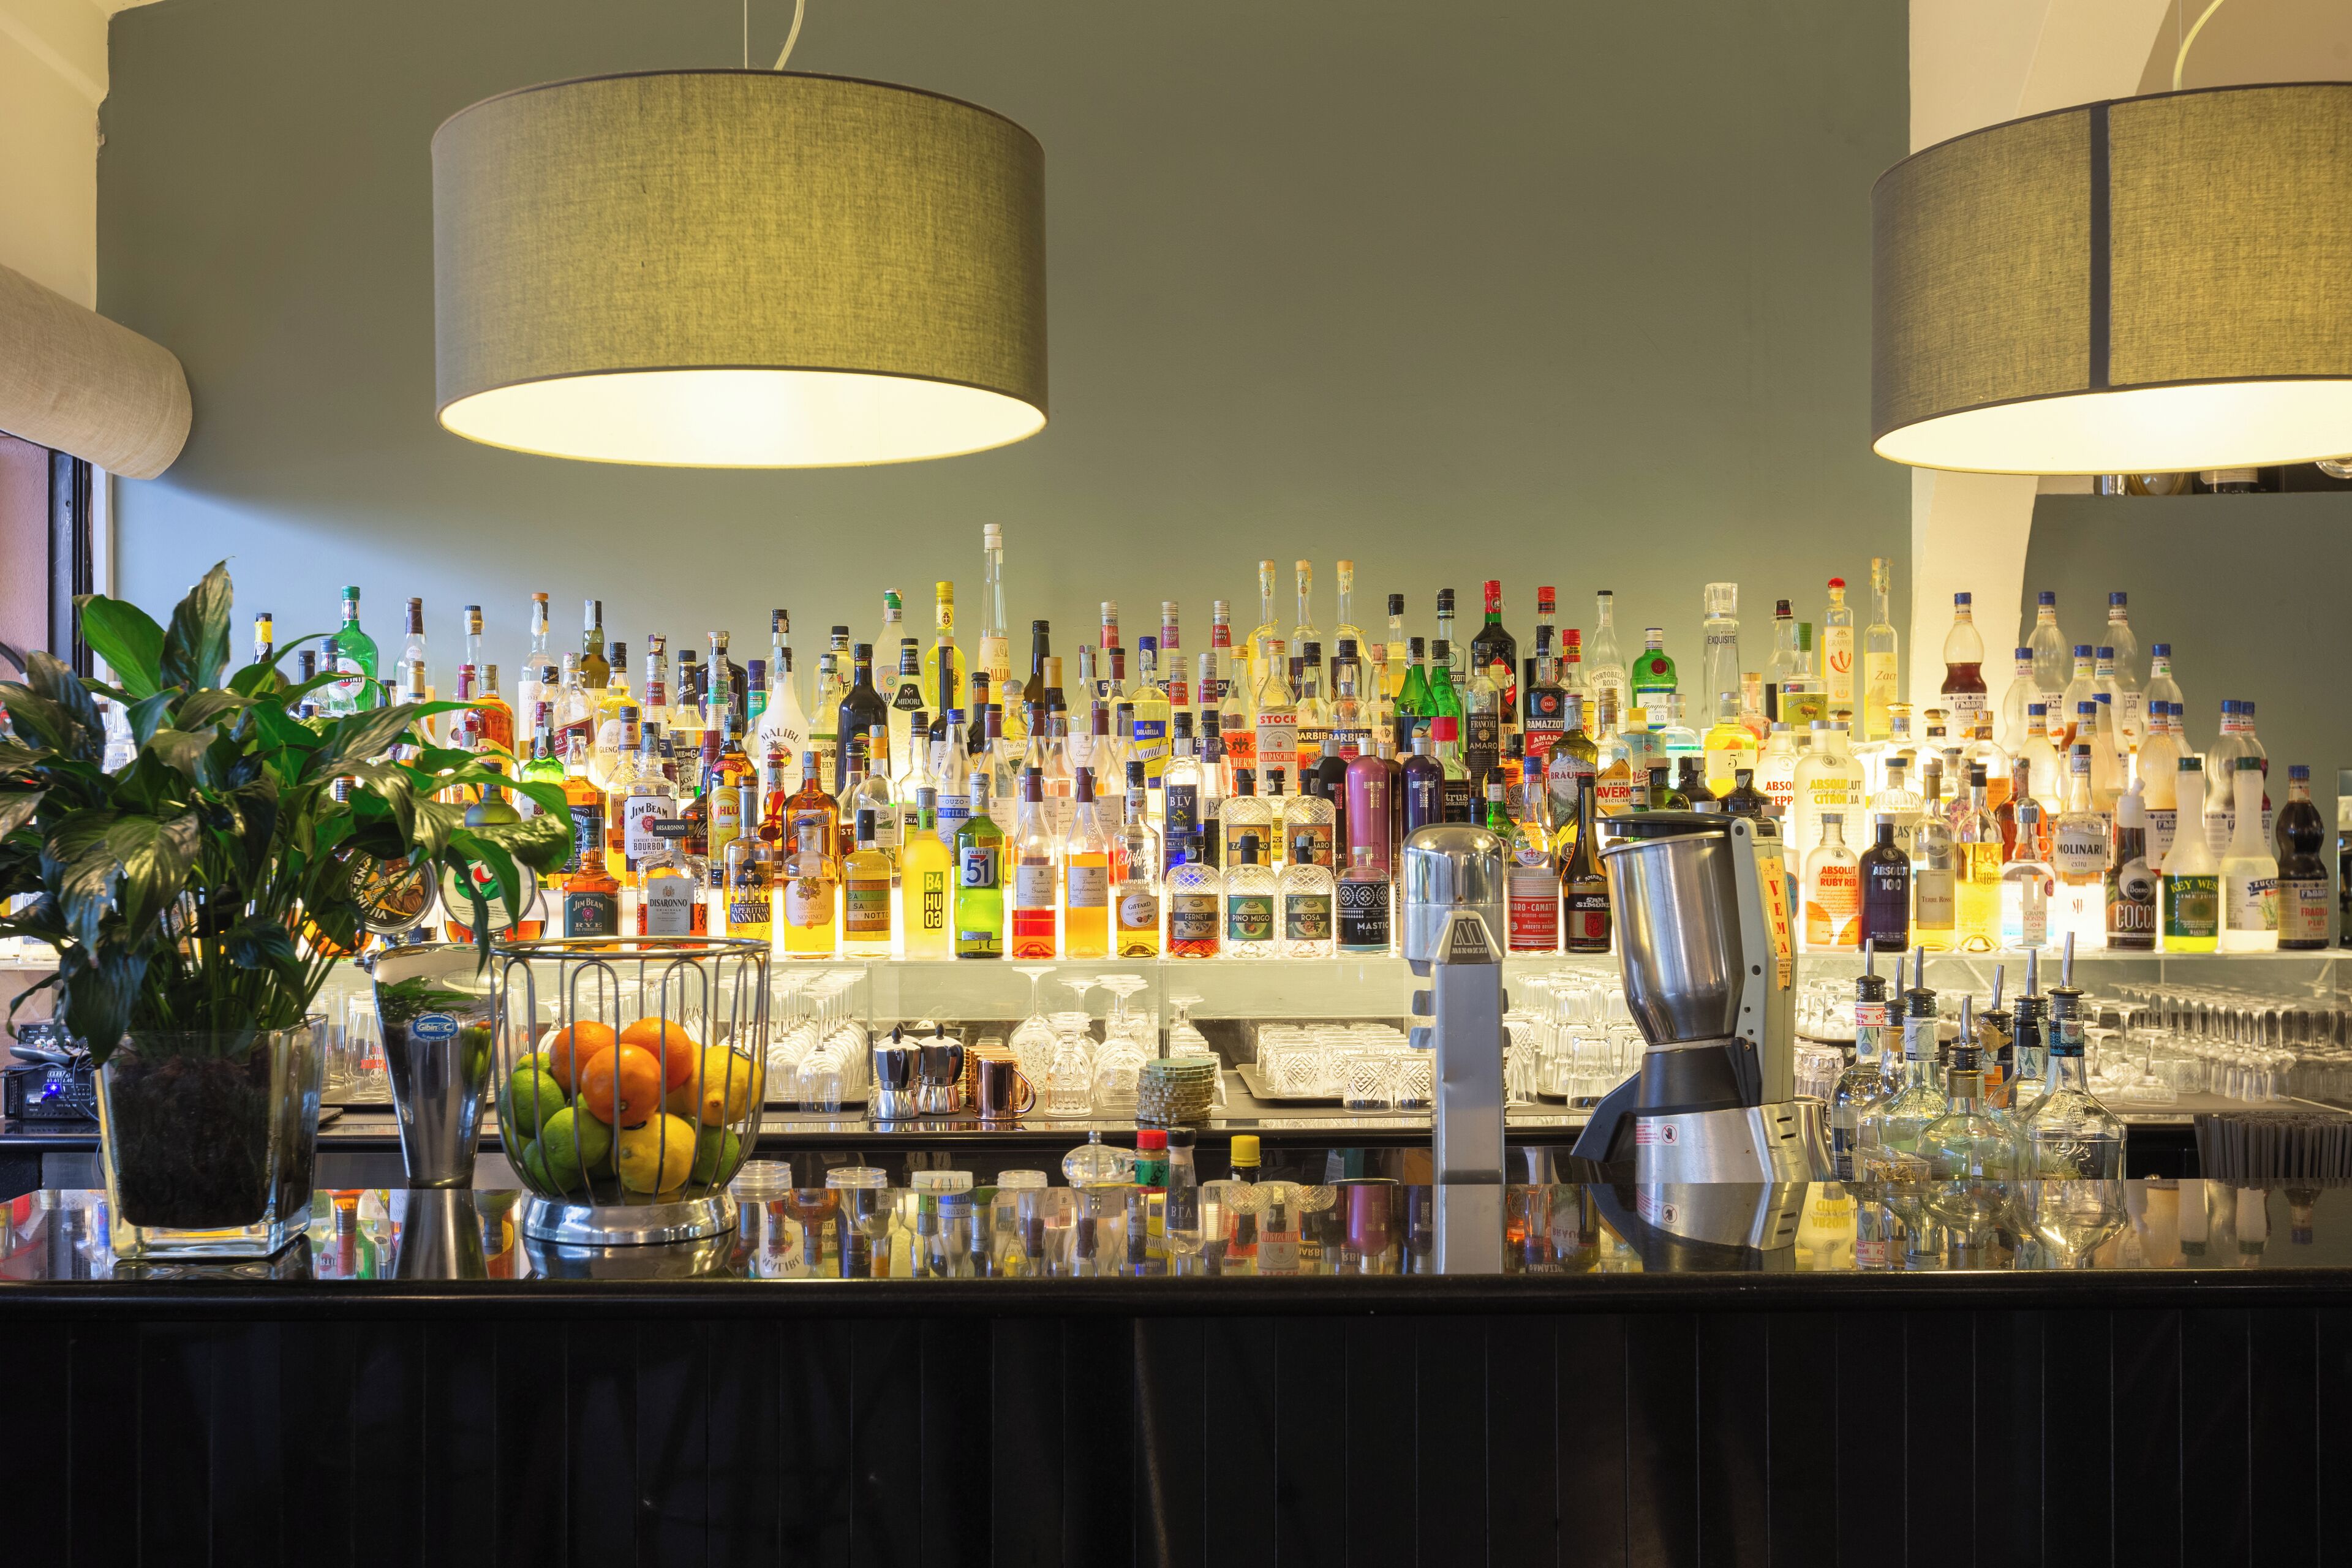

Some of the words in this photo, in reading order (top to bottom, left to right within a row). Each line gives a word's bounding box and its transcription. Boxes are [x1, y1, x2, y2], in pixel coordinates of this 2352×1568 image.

[1708, 635, 1736, 645] EXQUISITE
[1593, 671, 1624, 683] PORTOBELLO
[1260, 715, 1297, 725] STOCK
[761, 728, 801, 744] MALIBU
[1260, 752, 1297, 762] MARASCHINO
[1766, 781, 1794, 791] ABSO
[630, 806, 644, 819] JIM
[646, 802, 668, 818] BEAM
[2057, 843, 2102, 855] MOLINARI
[966, 859, 989, 883] 51
[1821, 866, 1856, 875] ABSOLUT
[1873, 866, 1908, 876] ABSOLUT
[925, 874, 941, 890] B4
[1881, 878, 1902, 891] 100
[2171, 880, 2195, 893] KEY
[573, 900, 586, 911] JIM
[586, 898, 603, 911] BEAM
[649, 899, 687, 908] DISARONNO
[926, 894, 942, 910] HU
[1128, 901, 1151, 910] GIFFARD
[732, 913, 769, 923] NONINO
[2116, 904, 2156, 929] COCCO
